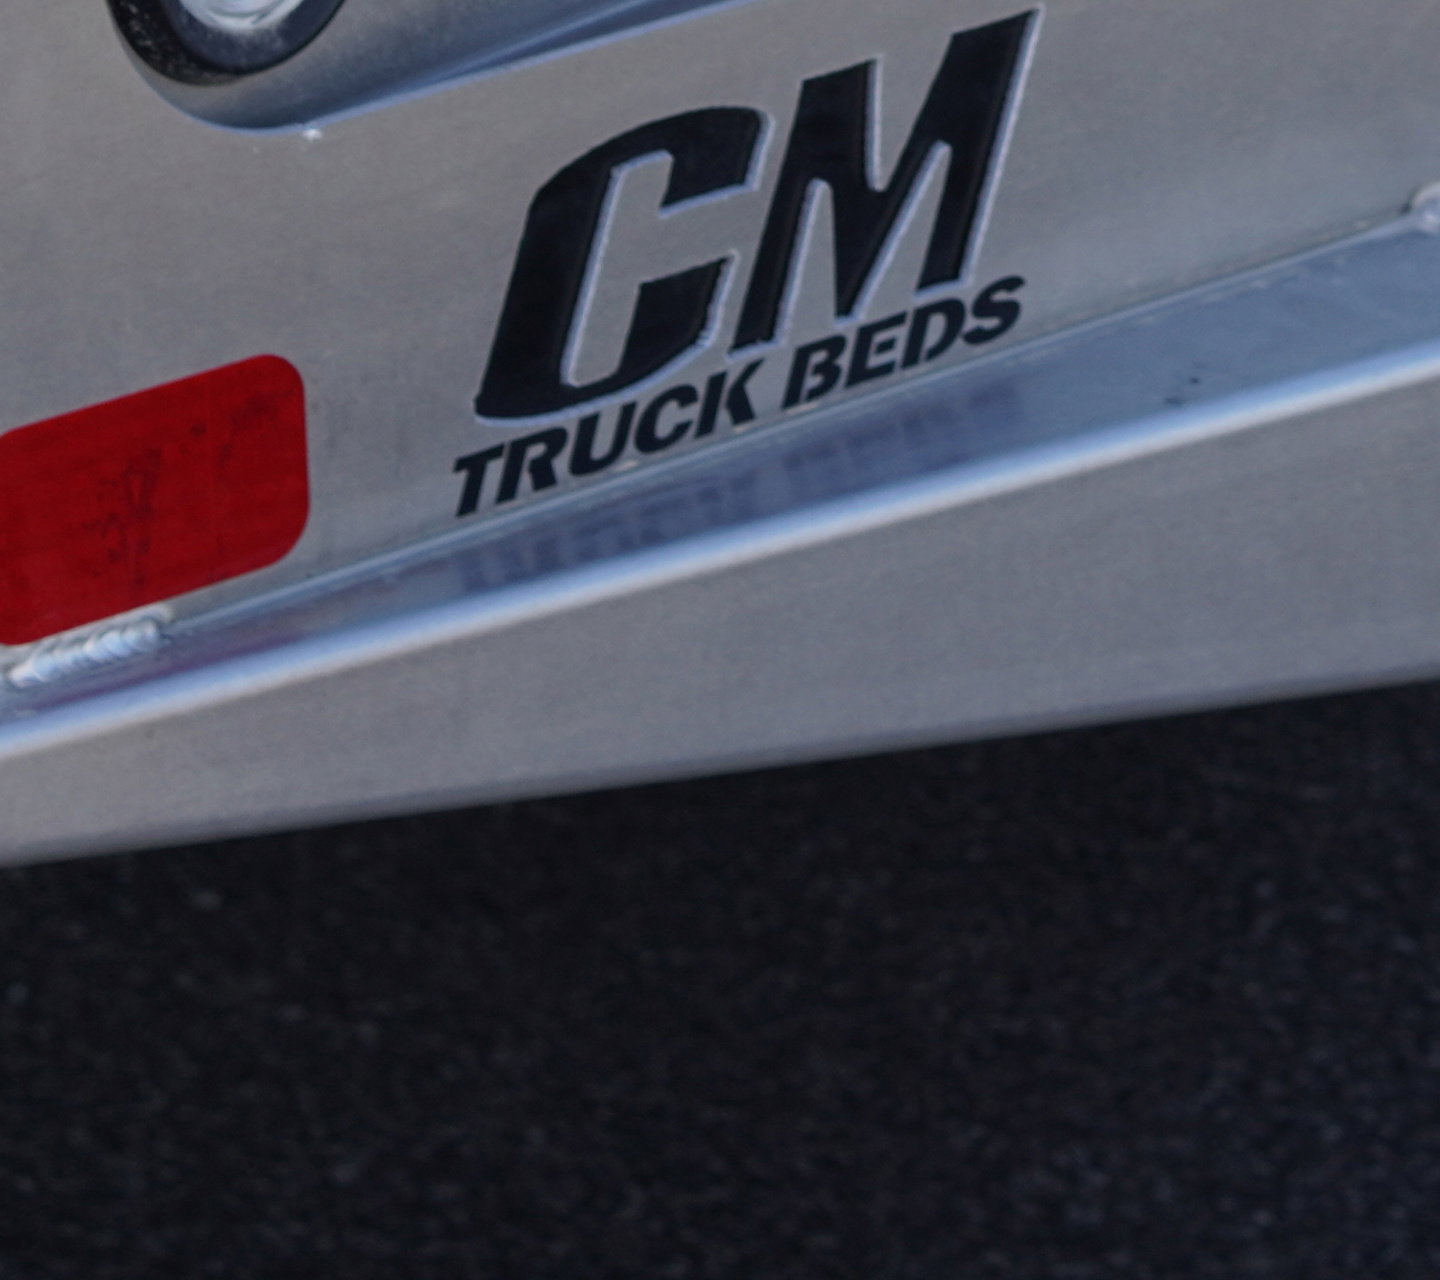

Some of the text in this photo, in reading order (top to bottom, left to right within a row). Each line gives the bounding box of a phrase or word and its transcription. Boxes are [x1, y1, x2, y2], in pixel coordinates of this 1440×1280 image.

[473, 5, 1042, 422] CM
[452, 275, 1027, 518] TRUCK BEDS
